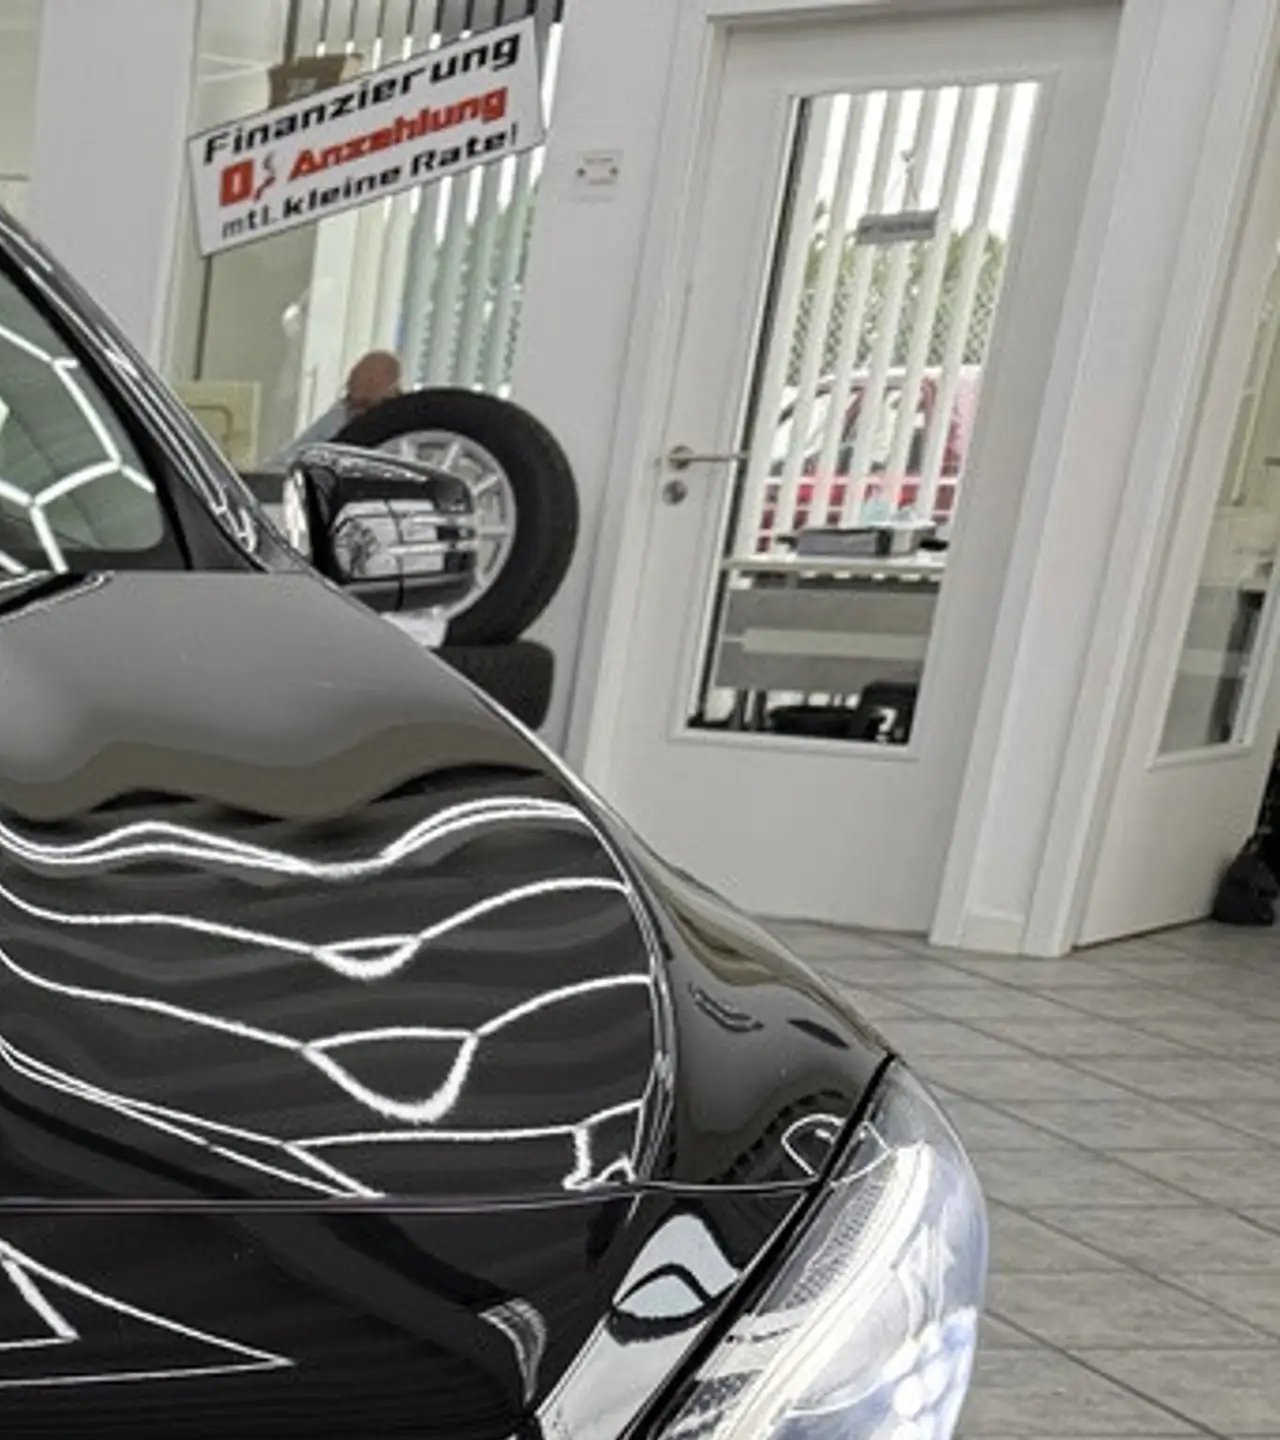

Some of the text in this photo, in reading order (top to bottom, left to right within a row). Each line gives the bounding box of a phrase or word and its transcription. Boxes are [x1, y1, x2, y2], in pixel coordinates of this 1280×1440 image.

[203, 32, 521, 165] Finanzierung
[289, 85, 510, 183] Anzahlung
[282, 164, 402, 221] kleine
